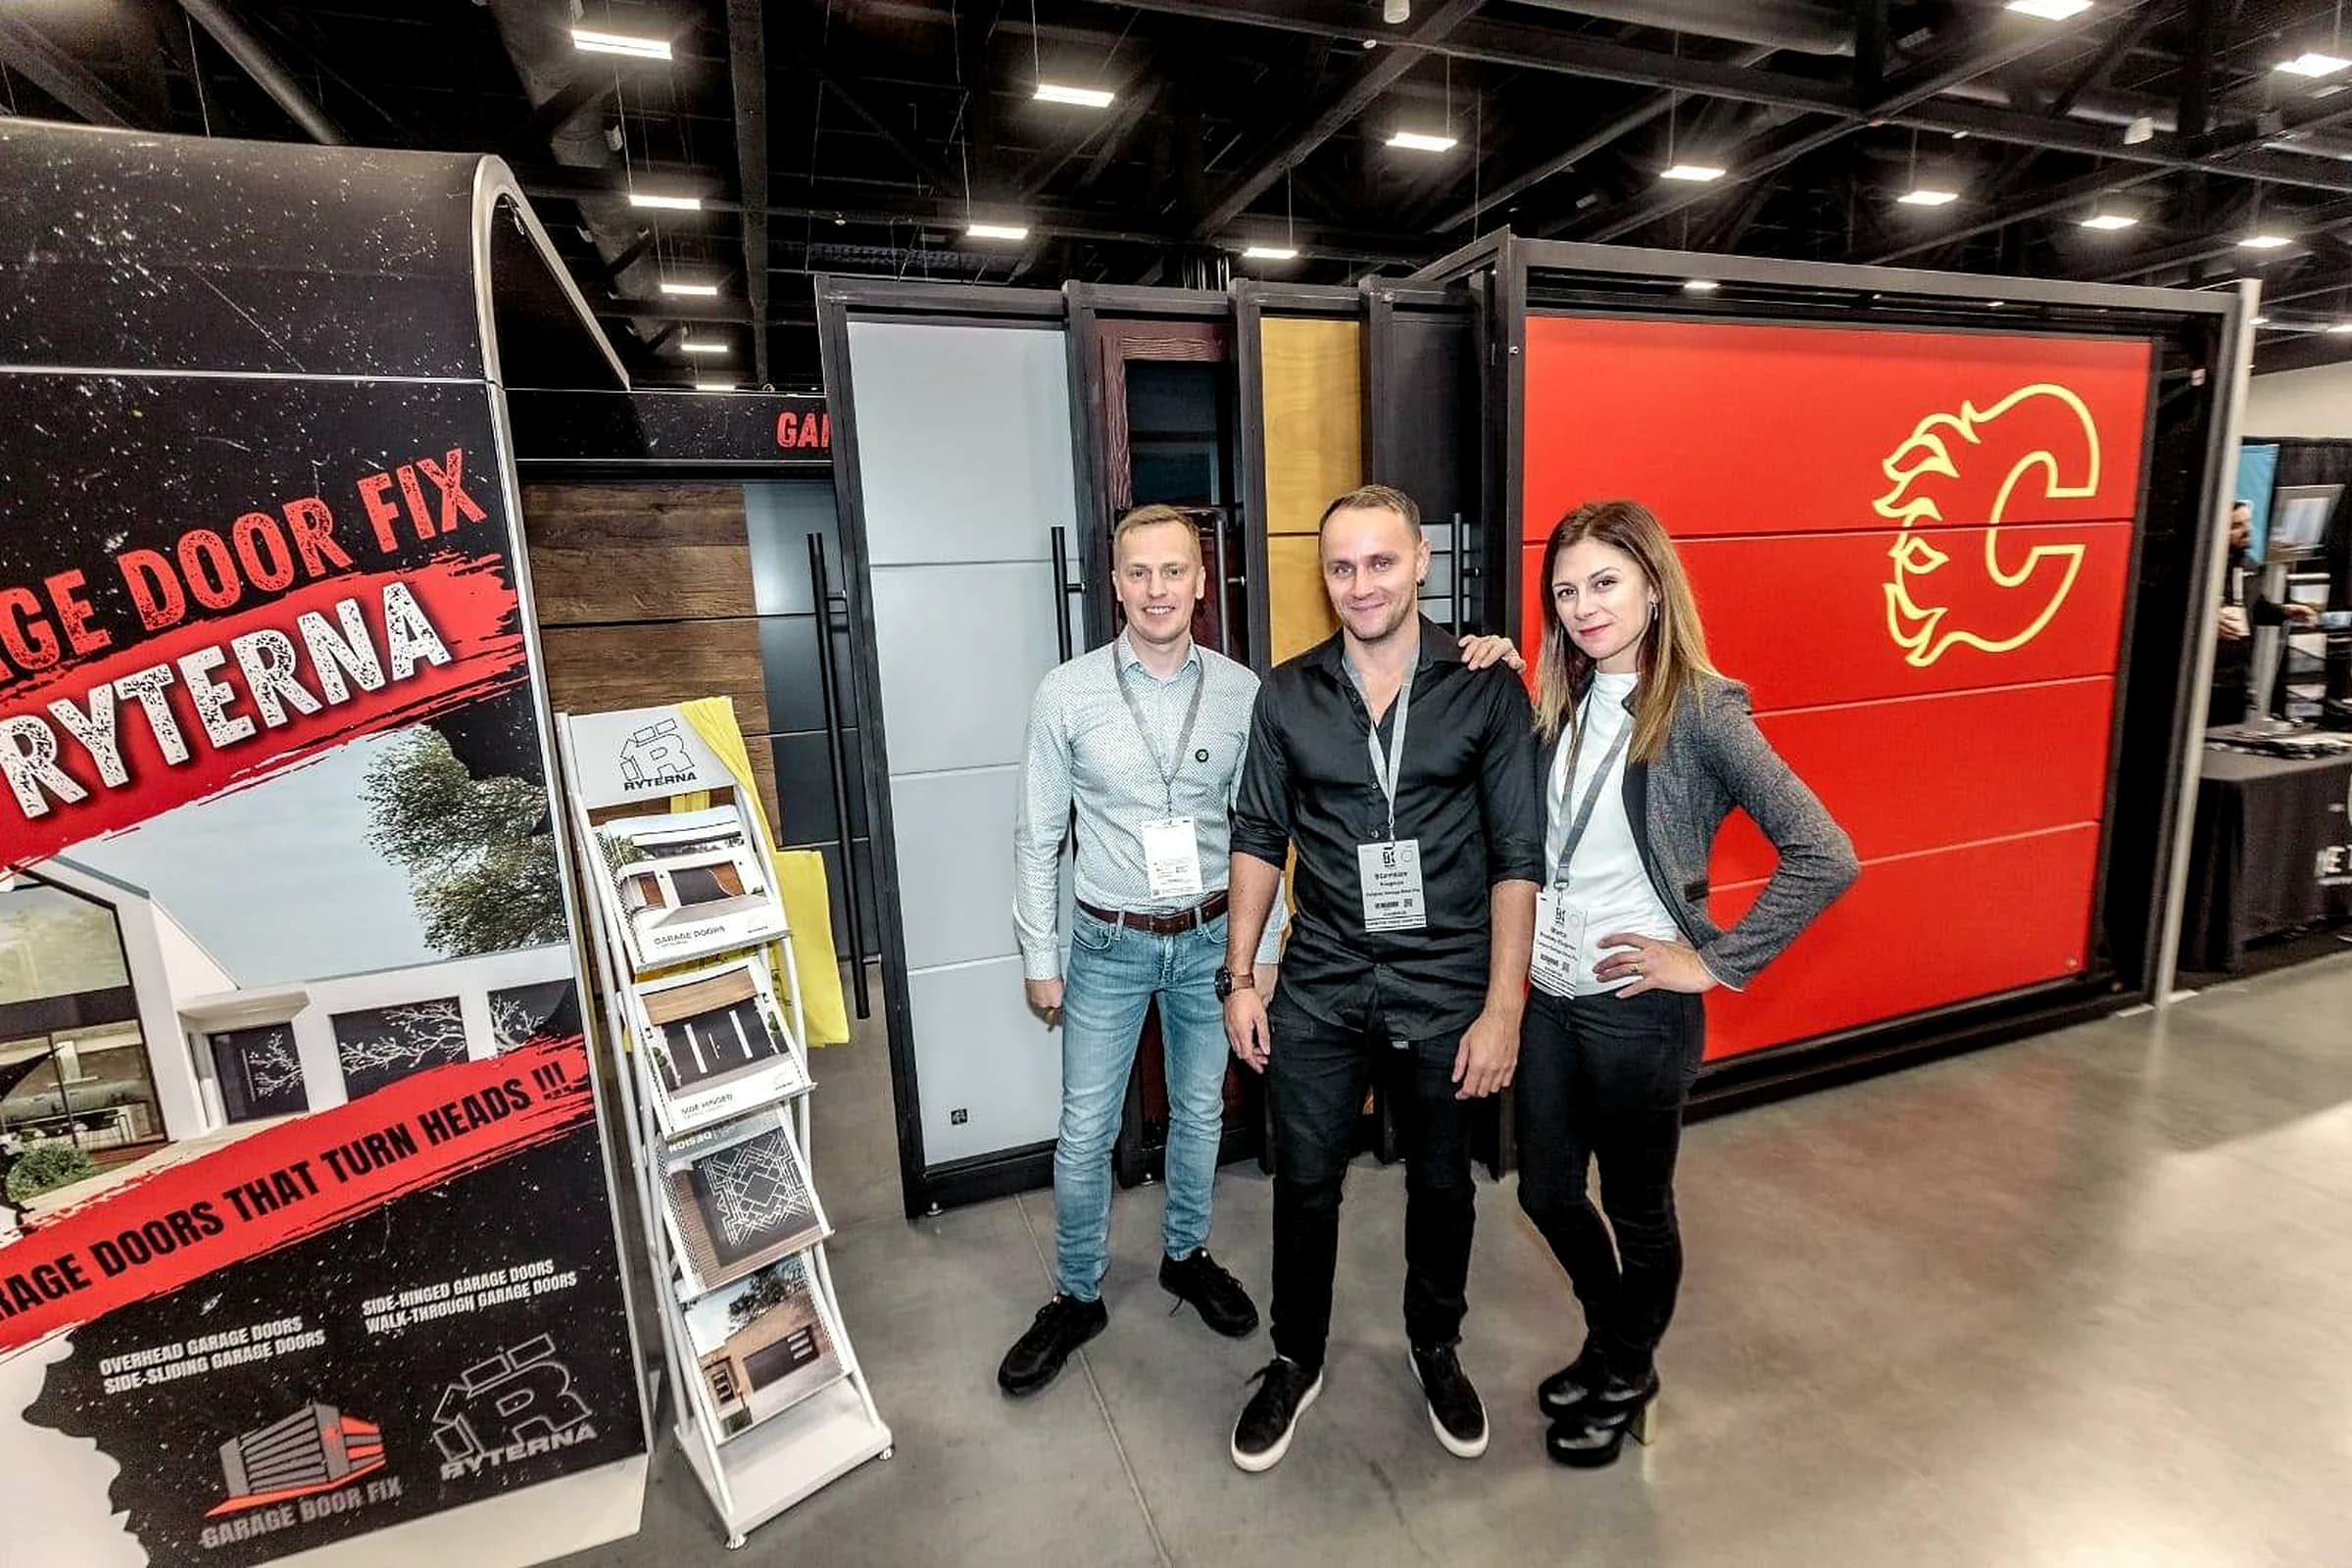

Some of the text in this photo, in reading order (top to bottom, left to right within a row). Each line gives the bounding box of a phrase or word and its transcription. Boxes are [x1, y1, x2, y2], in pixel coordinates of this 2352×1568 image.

[0, 448, 488, 680] GE DOOR FIX
[0, 581, 451, 819] RYTERNA
[623, 772, 698, 791] RYTERNA
[88, 1200, 224, 1278] DOORS
[223, 1160, 319, 1222] THAT
[320, 1123, 418, 1184] TURN
[417, 1078, 532, 1147] HEADS
[530, 1061, 574, 1100] !!!
[362, 1258, 555, 1316] SIDE-HINGED GARAGE DOORS
[365, 1271, 577, 1335] WALK-THROUGH GARAGE DOORS
[99, 1315, 304, 1376] OVERHEAD GARAGE DOORS
[103, 1329, 326, 1395] SIDE-SLIDING GARAGE DOORS
[440, 1423, 598, 1481] RYTERNA
[201, 1476, 404, 1549] GARAGE DOOR FIX
